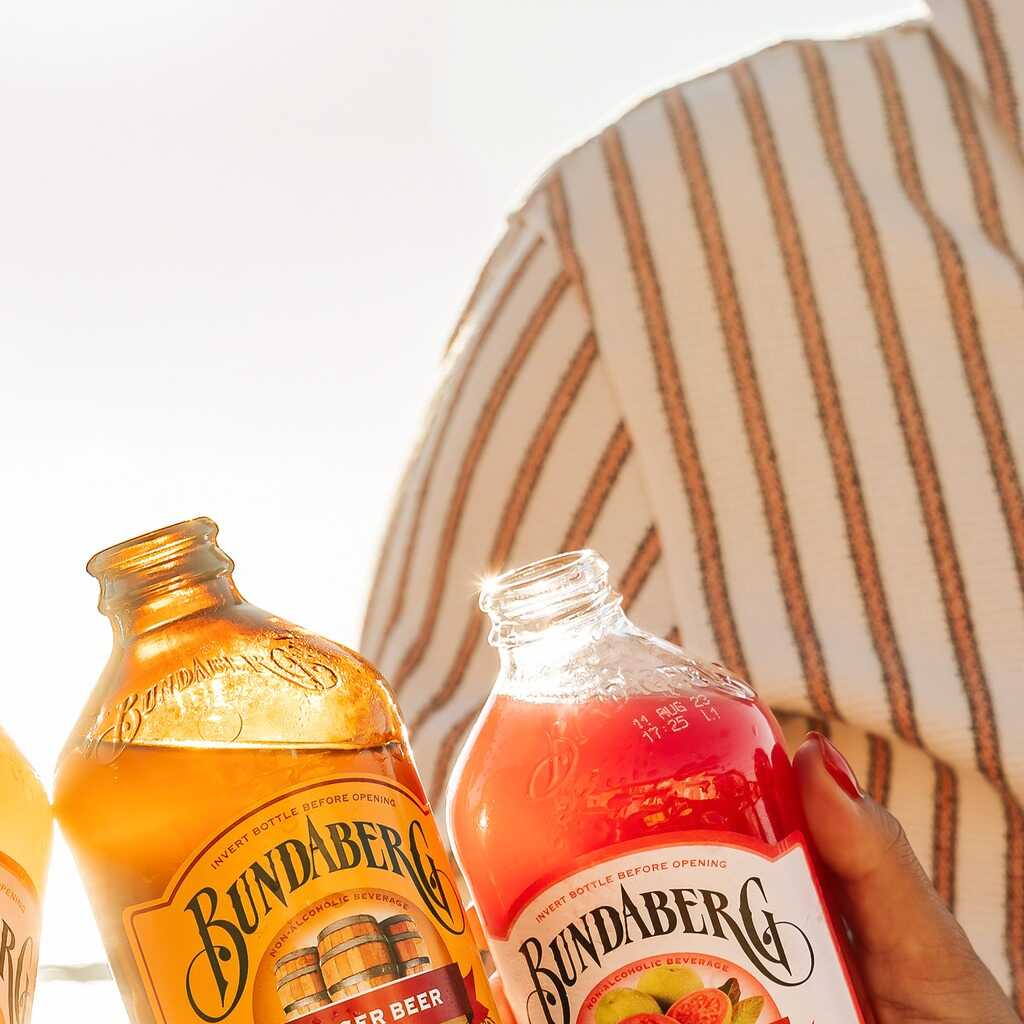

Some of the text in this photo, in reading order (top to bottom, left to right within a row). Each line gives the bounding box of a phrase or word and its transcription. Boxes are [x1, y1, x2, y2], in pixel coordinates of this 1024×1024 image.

[642, 716, 689, 742] 17:25
[656, 701, 688, 720] AUG
[210, 793, 396, 870] INVERT BOTTLE BEFORE OPENING
[183, 815, 466, 1023] BUNDABERG
[535, 859, 727, 924] INVERT BOTTLE BEFORE OPENING
[270, 892, 409, 958] NON-ALCOHOLIC BEVERAGE
[390, 988, 444, 1021] BEER
[587, 957, 730, 1011] NON-ALCOHOLIC BEVERAGE
